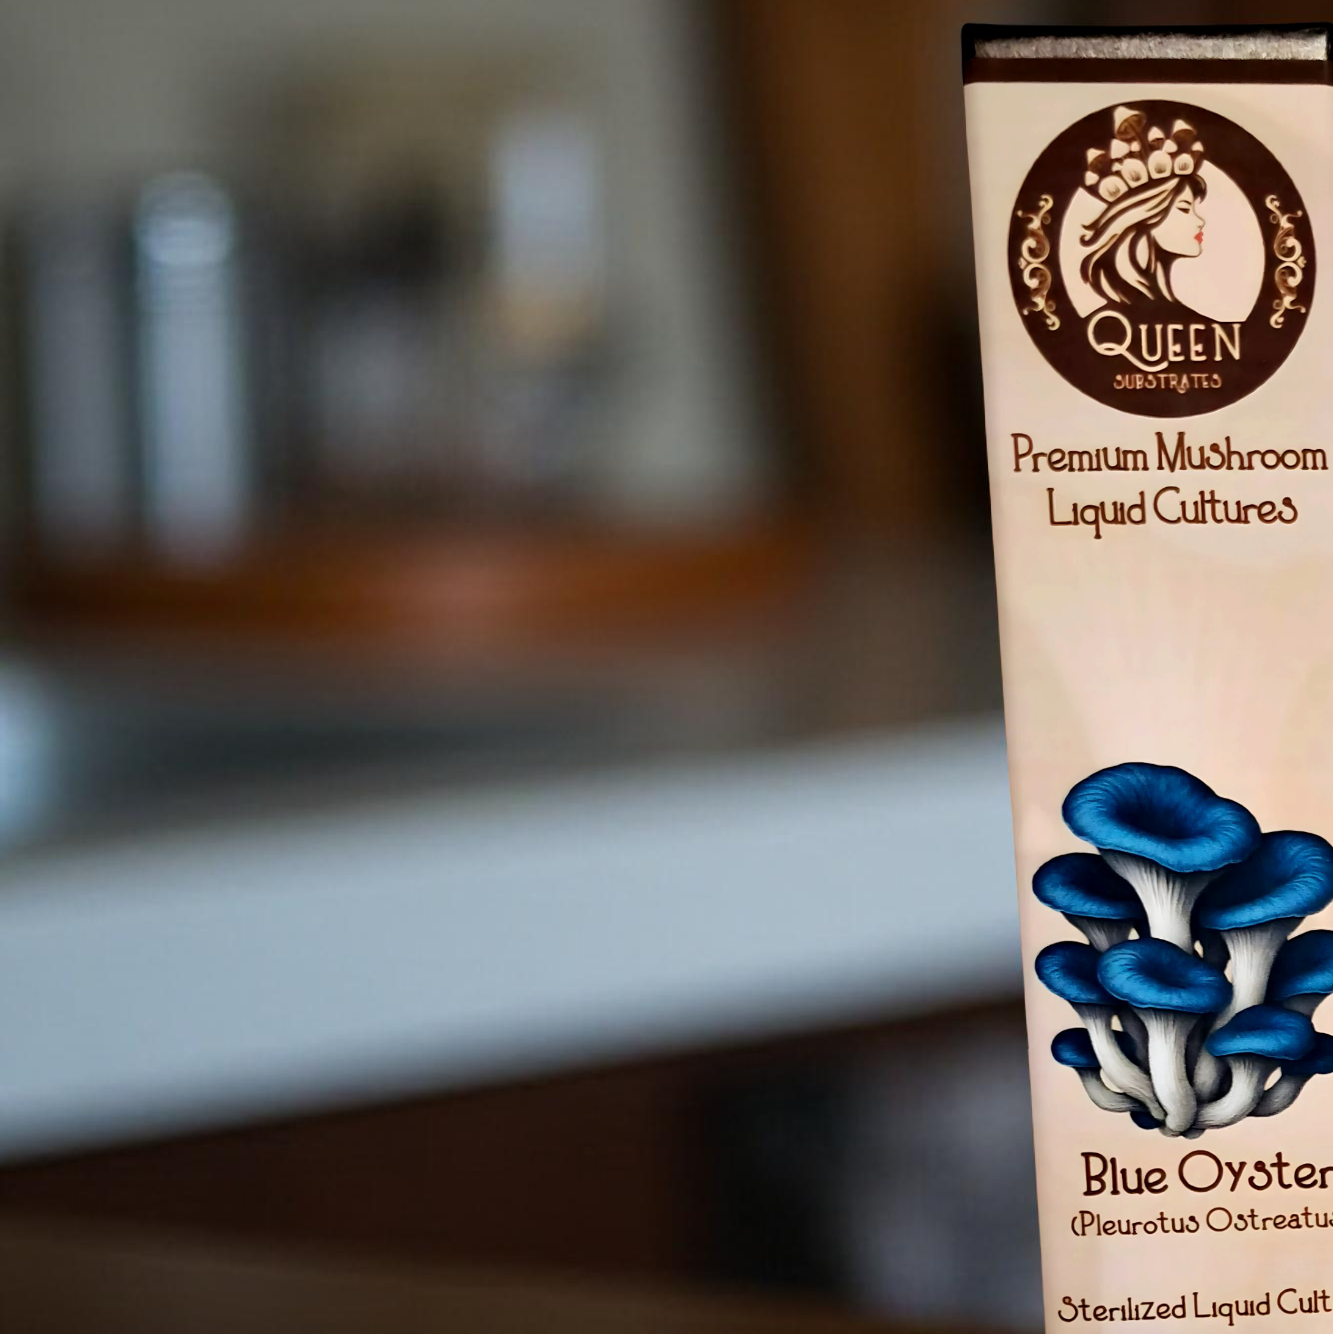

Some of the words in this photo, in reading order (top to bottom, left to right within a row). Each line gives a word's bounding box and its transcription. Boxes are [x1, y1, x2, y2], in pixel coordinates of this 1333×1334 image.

[1087, 309, 1241, 372] QUEEN
[1113, 372, 1222, 394] SUBSTRATES
[1010, 432, 1150, 473] Premium
[1154, 430, 1330, 474] Mushroom
[1045, 487, 1147, 540] Liquid
[1152, 485, 1299, 525] Cultures
[1080, 1151, 1169, 1197] Blue
[1070, 1209, 1201, 1237] (Pleurotus
[1057, 1294, 1187, 1323] Sterilized
[1191, 1291, 1271, 1327] Liquid
